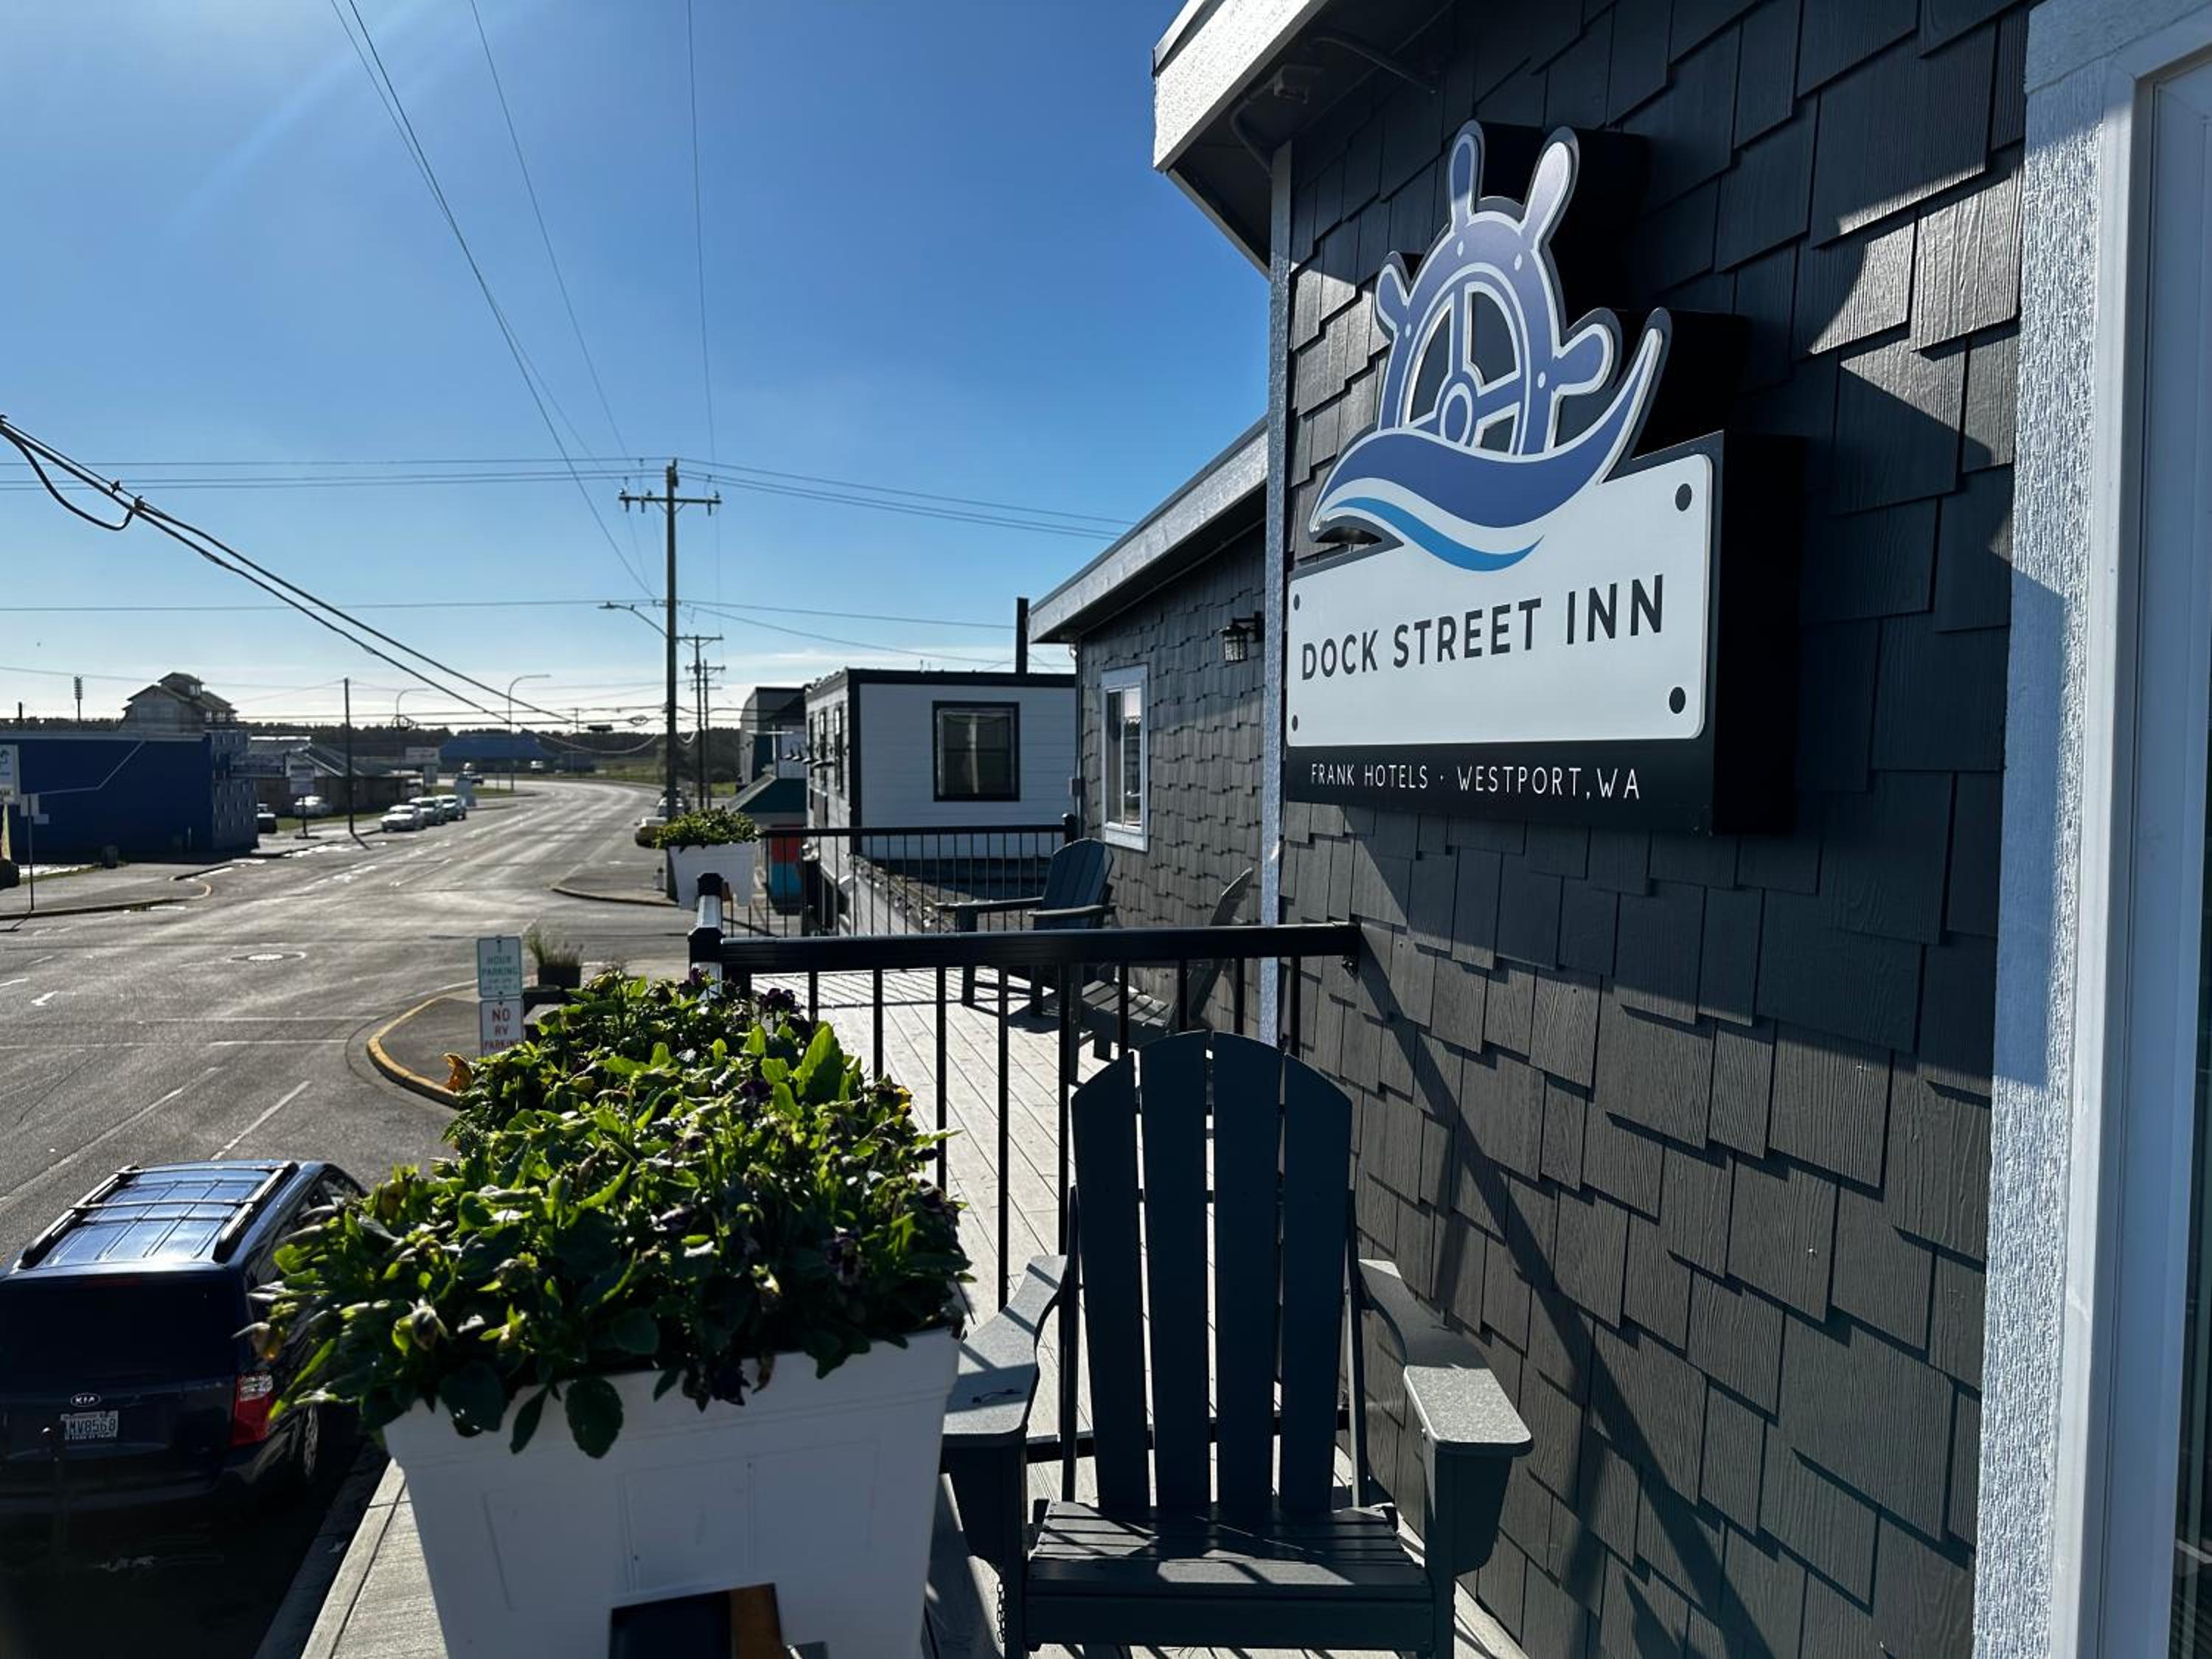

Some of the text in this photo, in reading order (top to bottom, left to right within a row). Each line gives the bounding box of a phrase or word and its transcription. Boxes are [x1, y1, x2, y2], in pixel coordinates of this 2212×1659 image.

[1301, 574, 1663, 680] DOCK STREET INN
[1311, 764, 1355, 786] FRANK
[1364, 765, 1428, 789] HOTELS
[492, 1008, 510, 1023] NO
[75, 1396, 95, 1405] KIA
